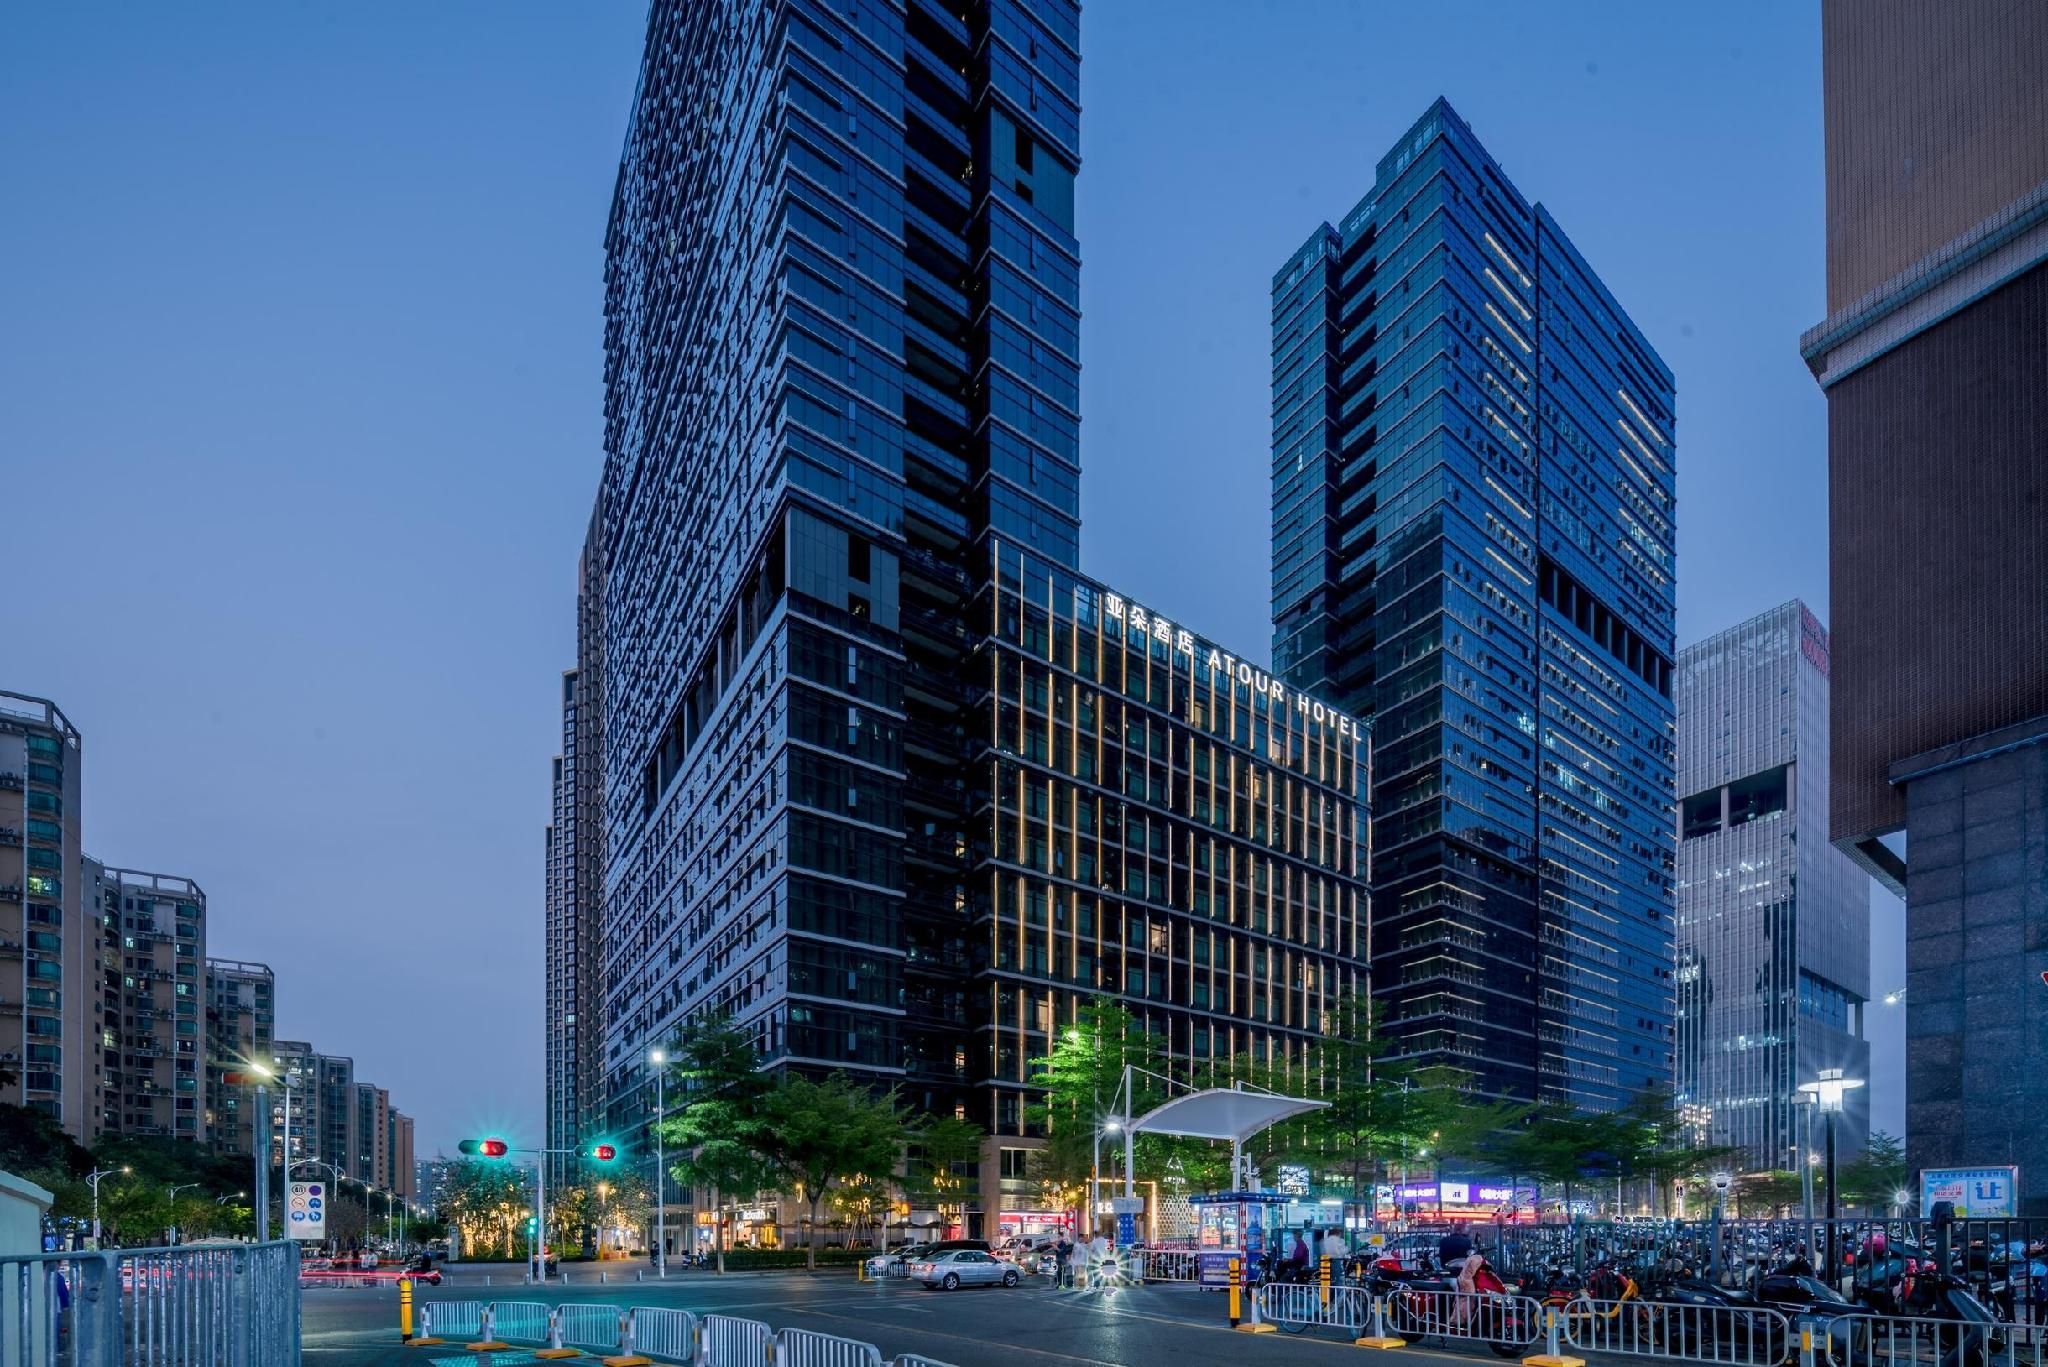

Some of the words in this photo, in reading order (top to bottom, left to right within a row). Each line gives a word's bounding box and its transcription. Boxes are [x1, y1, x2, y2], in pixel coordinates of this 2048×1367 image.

[1106, 592, 1194, 655] 亚朵酒店
[1208, 649, 1284, 702] ATOUR
[1298, 693, 1361, 742] HOTEL
[1975, 1182, 2002, 1200] 让
